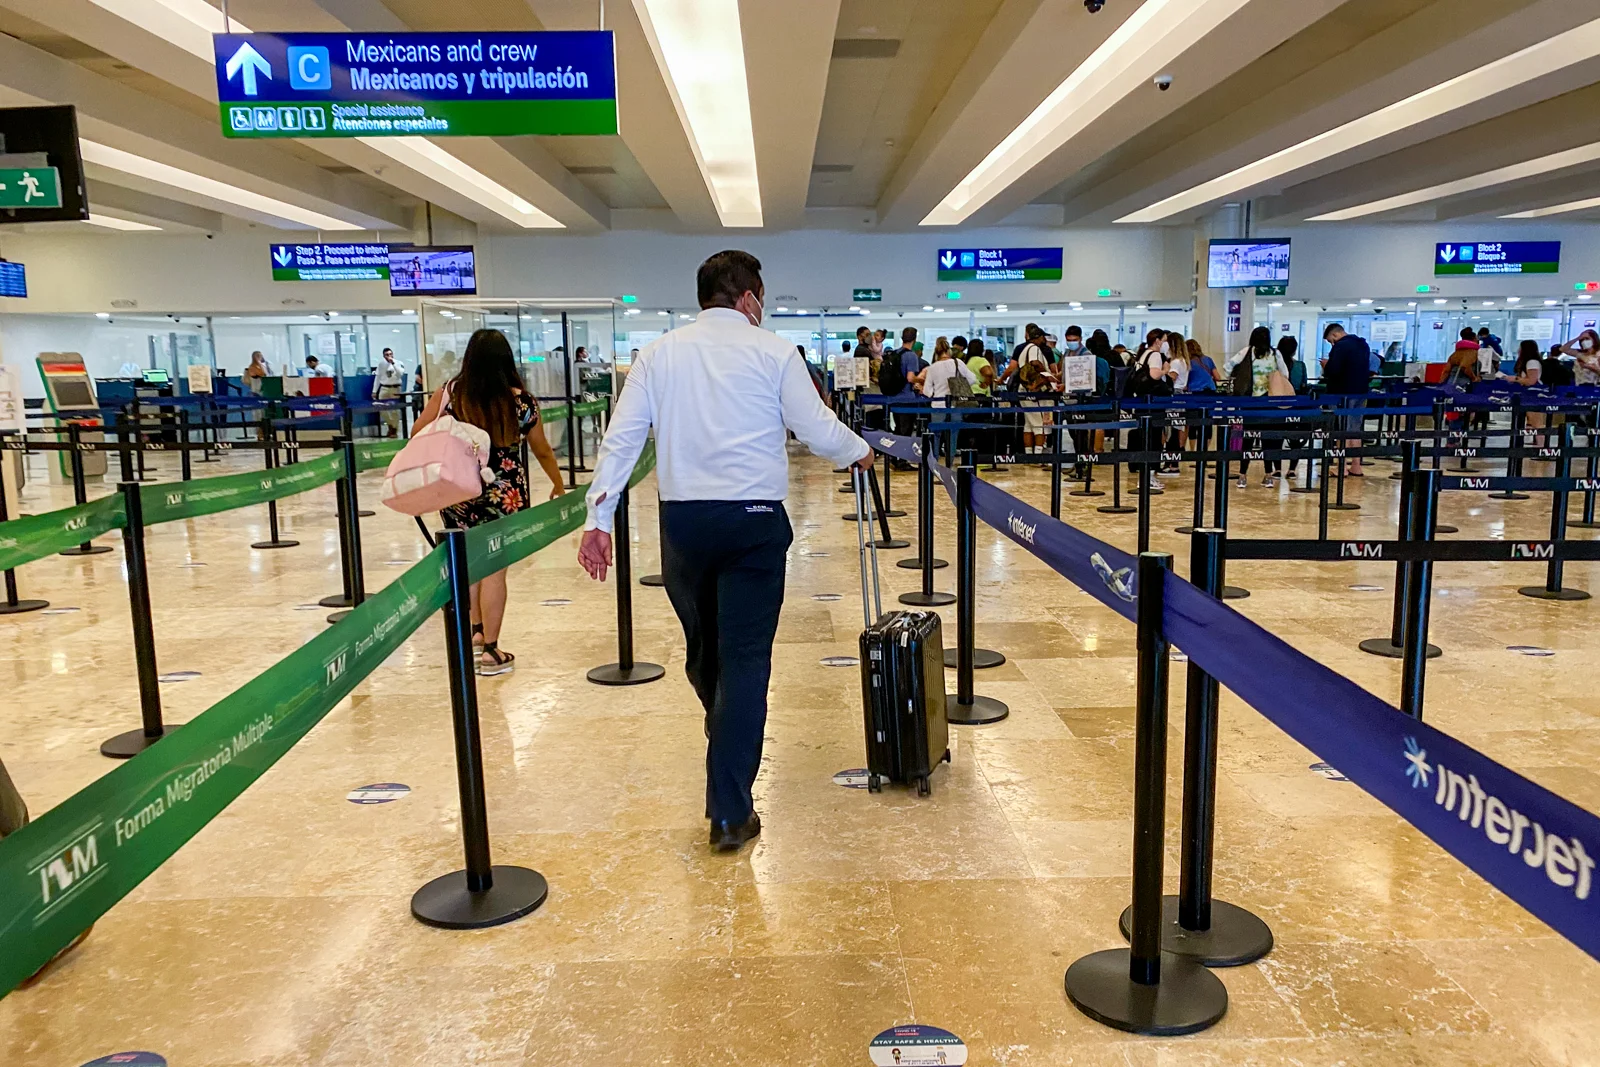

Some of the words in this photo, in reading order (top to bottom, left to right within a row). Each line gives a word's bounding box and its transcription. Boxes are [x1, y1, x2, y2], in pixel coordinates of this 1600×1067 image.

[346, 39, 441, 63] Mexicans
[447, 39, 483, 62] and
[489, 44, 537, 62] crew
[298, 53, 321, 83] C
[350, 66, 458, 91] Mexicanos
[462, 72, 475, 95] y
[480, 65, 589, 94] tripulación
[331, 103, 368, 118] Special
[369, 103, 425, 117] assistance
[332, 116, 392, 131] Atenciones
[393, 116, 449, 132] especiales
[296, 246, 313, 256] Step
[324, 245, 355, 255] Proceed
[355, 245, 365, 255] to
[979, 250, 998, 259] Block
[998, 250, 1002, 259] 1
[1478, 244, 1496, 252] Block
[1496, 243, 1501, 252] 2
[979, 259, 1002, 268] Bloque
[1003, 258, 1007, 267] 1
[1478, 252, 1500, 261] Bloque
[1501, 252, 1506, 260] 2
[114, 797, 165, 847] Forma
[165, 745, 232, 803] Migratoria
[232, 712, 275, 763] Múltiple
[1435, 763, 1596, 900] interjet
